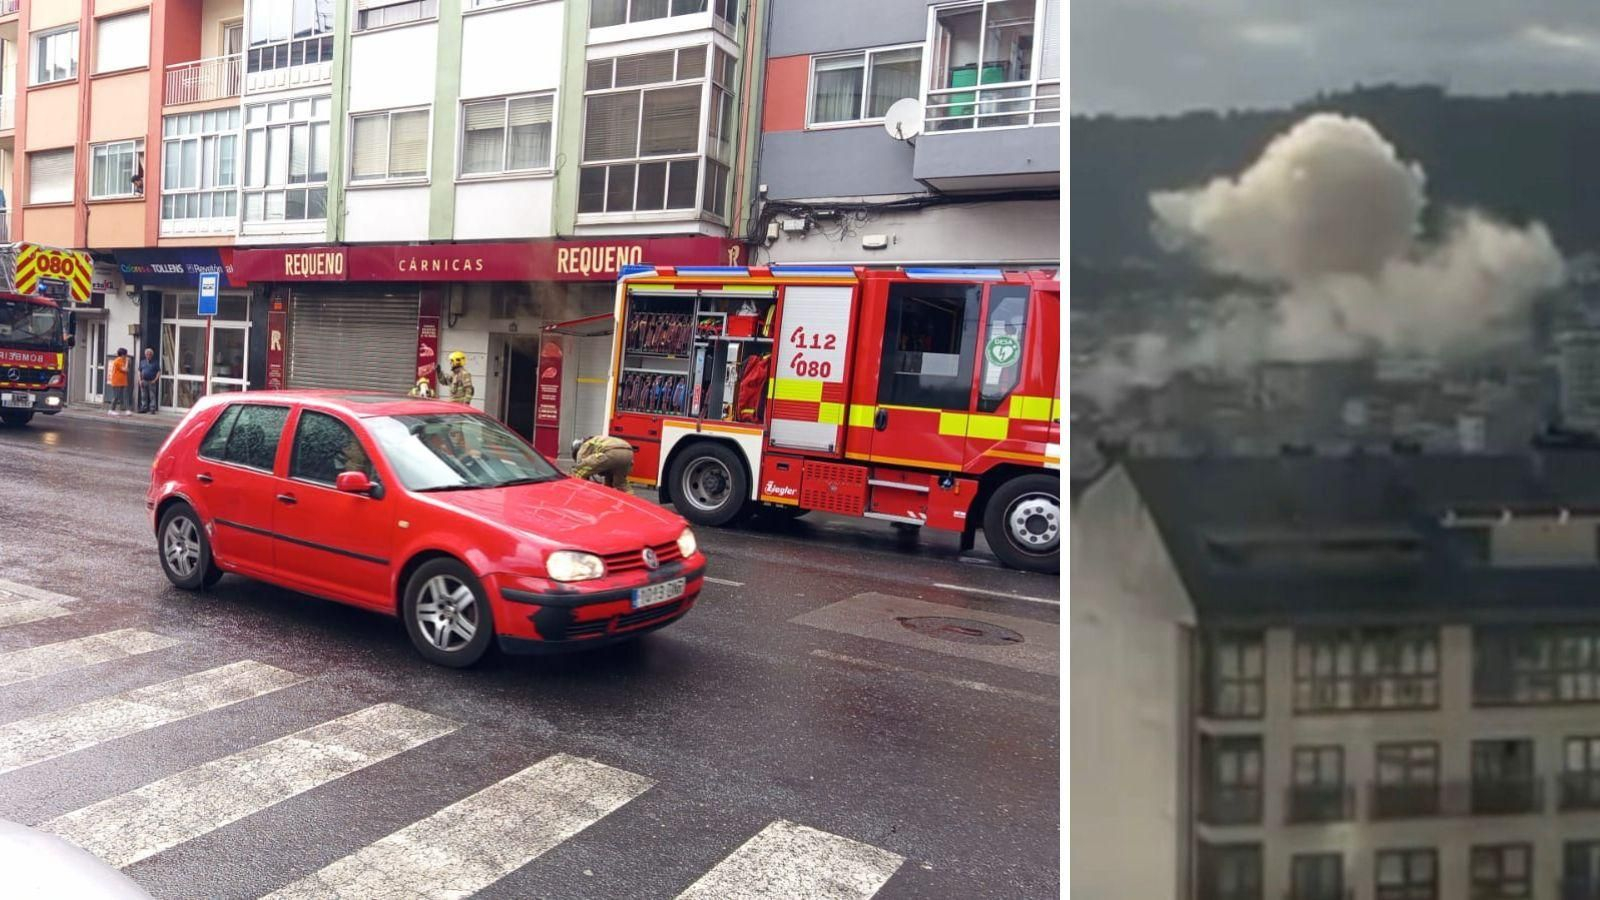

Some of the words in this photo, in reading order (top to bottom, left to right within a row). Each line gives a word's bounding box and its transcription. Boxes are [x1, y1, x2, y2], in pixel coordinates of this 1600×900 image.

[37, 254, 74, 275] 080
[151, 263, 184, 273] TOLLENS
[285, 252, 343, 278] REQUENO
[399, 257, 484, 271] CÁRNICAS
[557, 245, 643, 276] REQUENO
[270, 330, 282, 351] R
[796, 332, 836, 350] 112
[796, 360, 831, 378] 080
